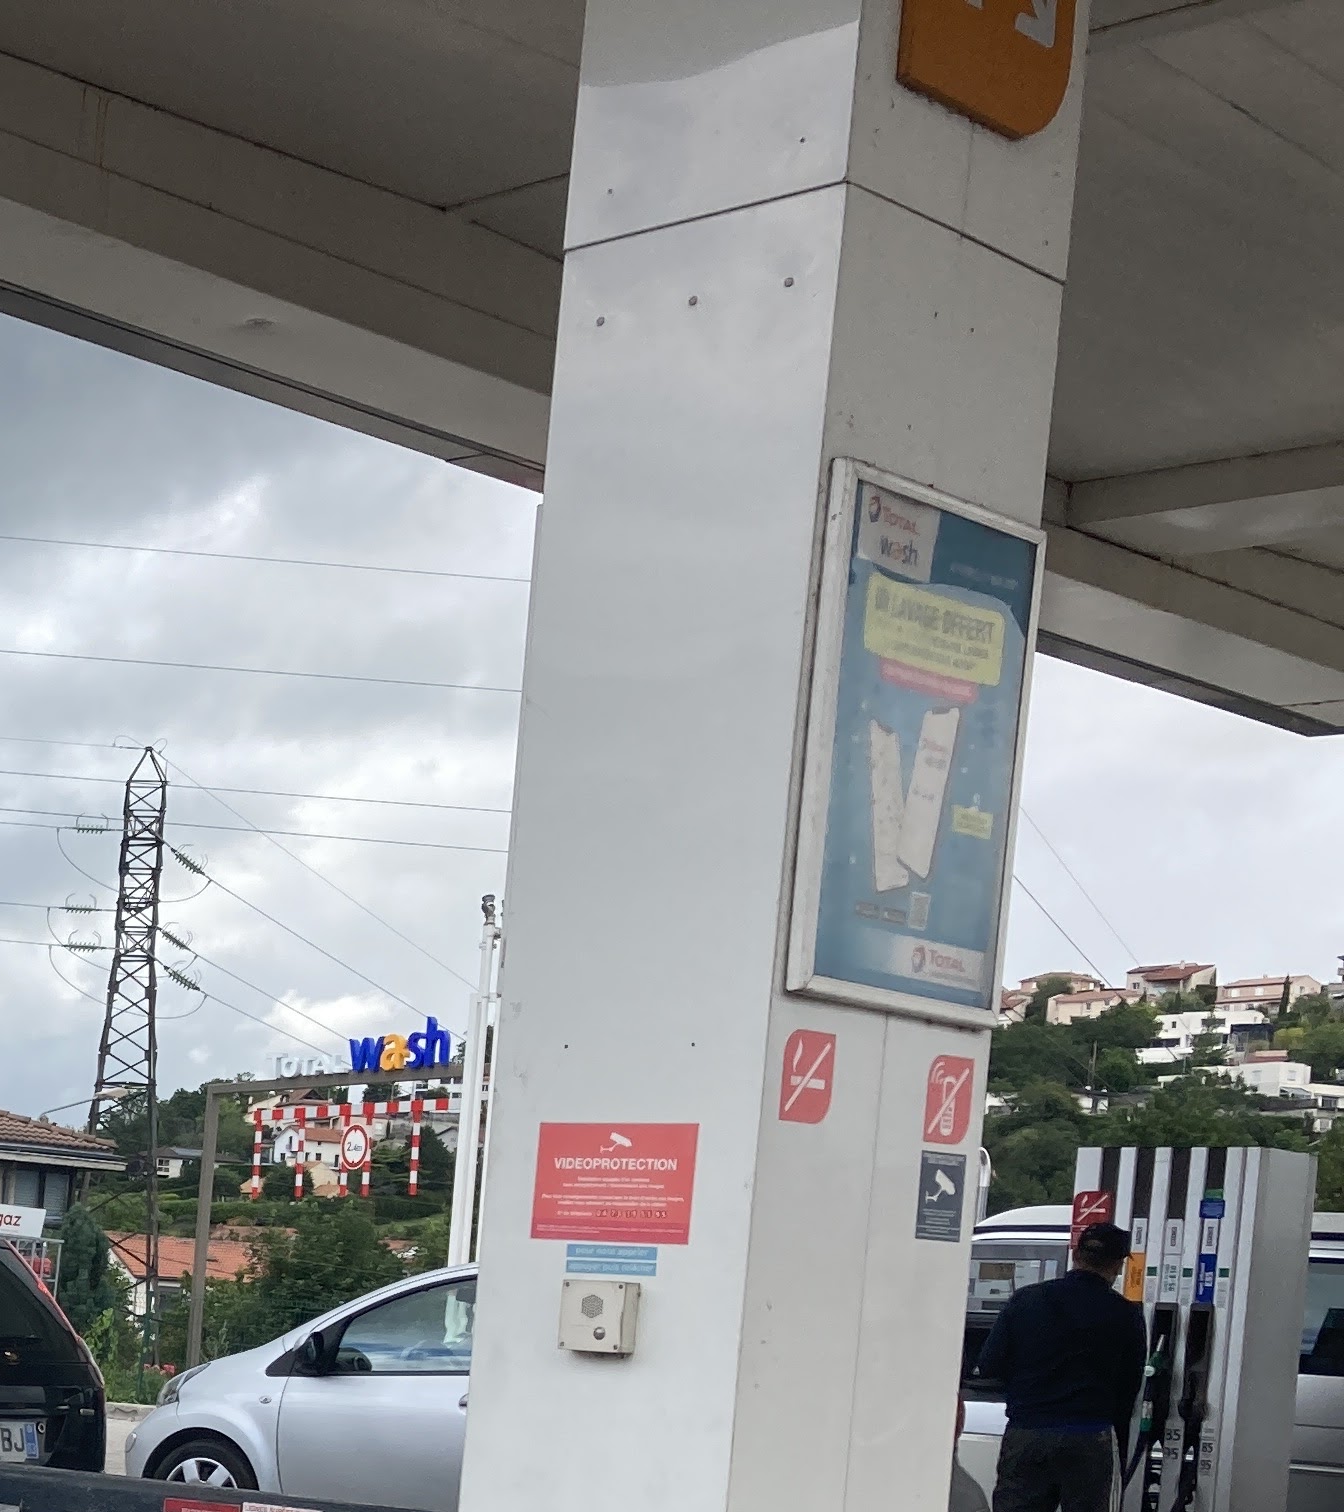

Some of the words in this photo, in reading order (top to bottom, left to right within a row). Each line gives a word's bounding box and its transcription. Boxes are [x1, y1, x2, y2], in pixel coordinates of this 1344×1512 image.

[928, 949, 966, 972] TOTAL
[266, 1053, 350, 1079] TOTAL
[349, 1016, 451, 1073] wash
[554, 1157, 678, 1171] VIDEOPROTECTION
